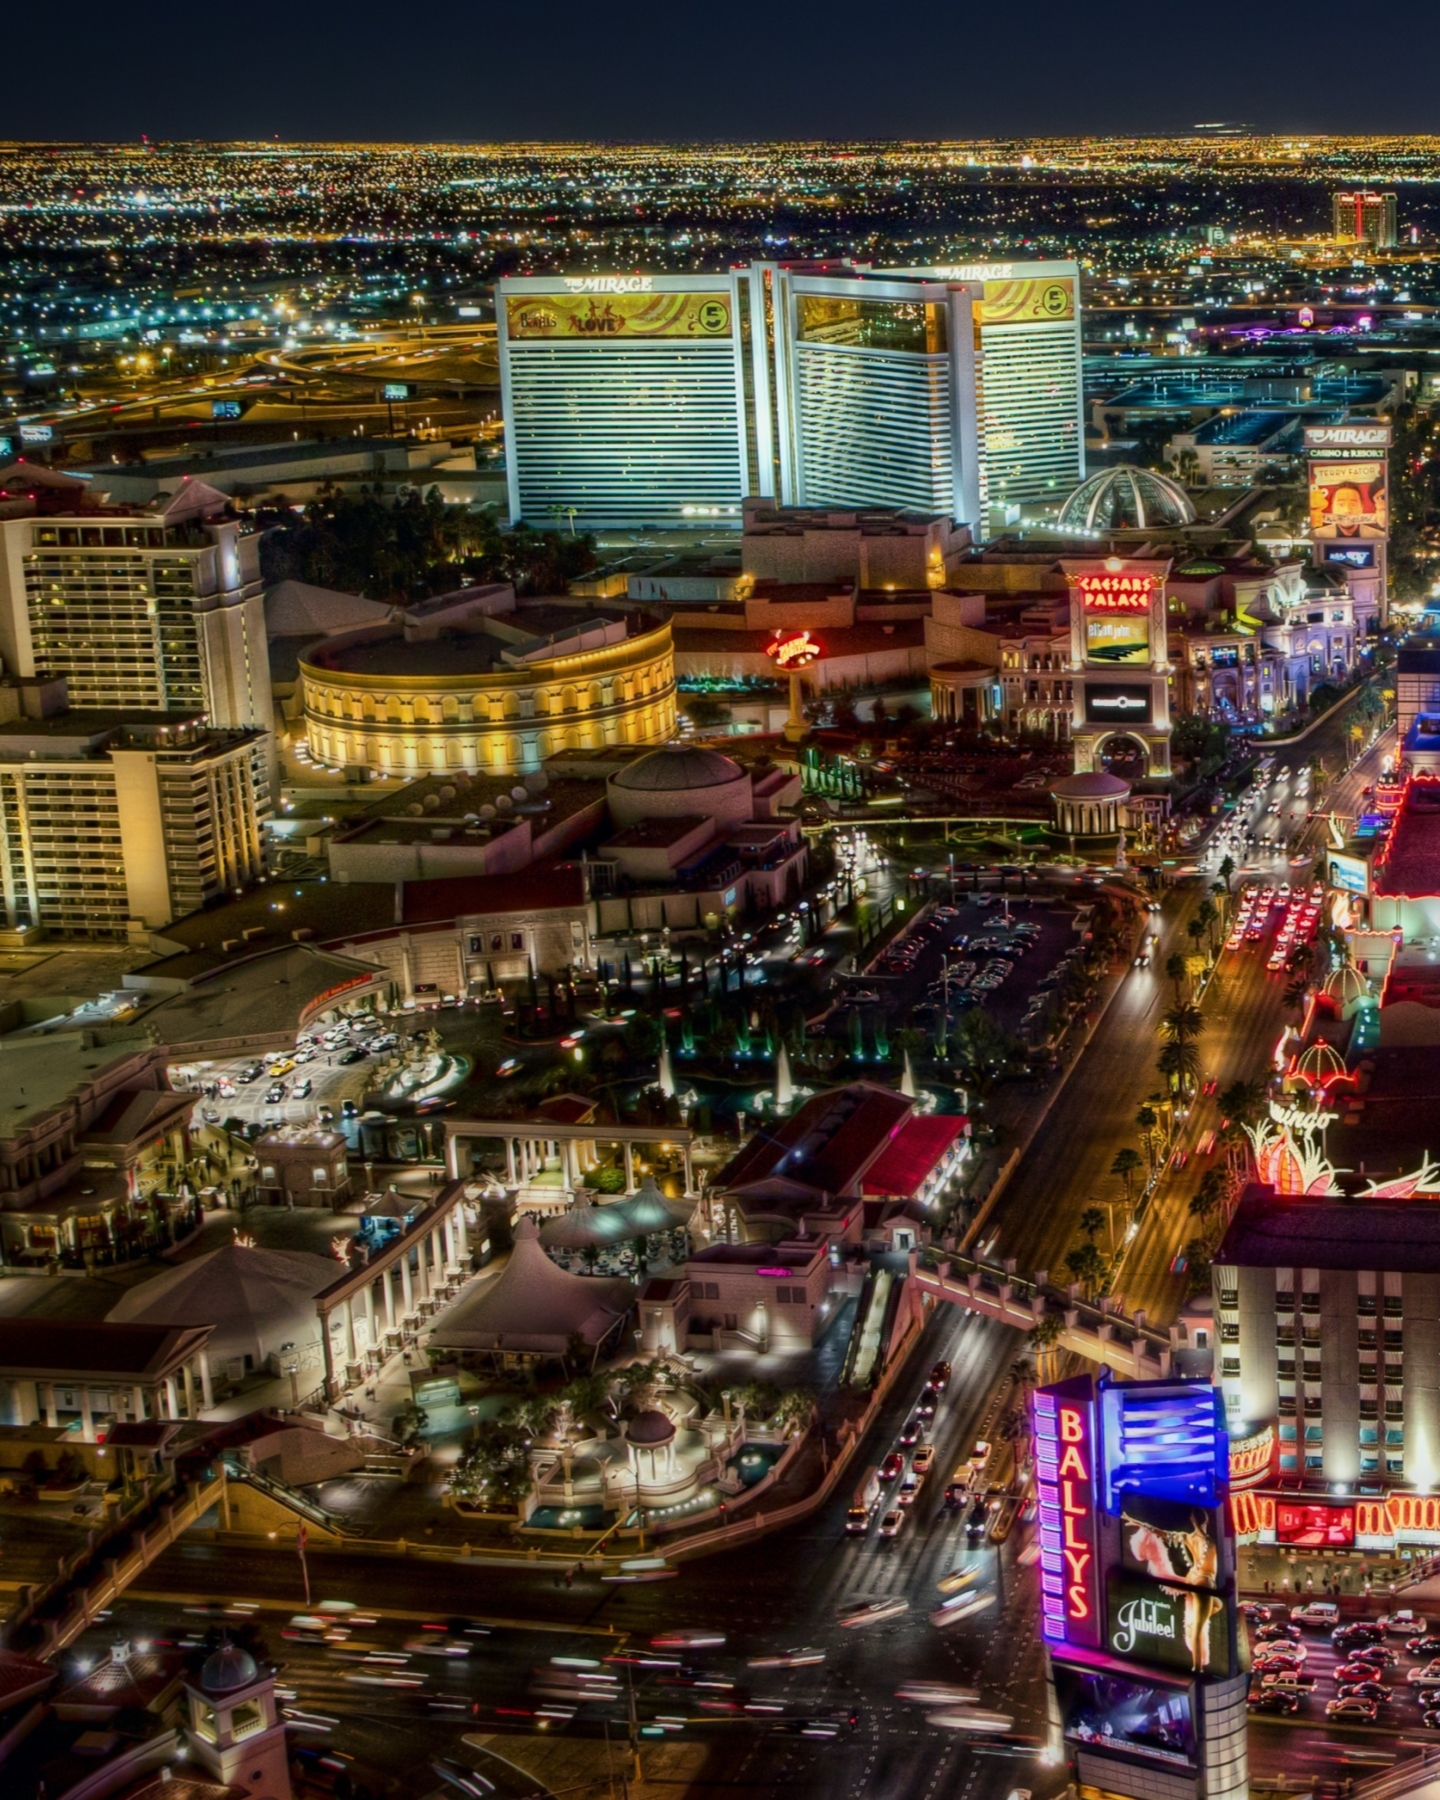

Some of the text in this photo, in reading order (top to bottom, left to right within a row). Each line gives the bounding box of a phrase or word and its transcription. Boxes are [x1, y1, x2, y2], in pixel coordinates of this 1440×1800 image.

[950, 265, 1013, 281] MIRAGE
[564, 277, 652, 293] THE MIRAGE
[577, 318, 616, 332] LOVE
[1307, 430, 1387, 444] THE MIRAGE
[1310, 449, 1384, 458] CASINO & RESORT
[1319, 467, 1375, 477] TERRY FATOR
[1080, 578, 1151, 591] CAESARS
[1085, 593, 1148, 607] PALACE
[1088, 623, 1130, 640] elton john
[1113, 1599, 1175, 1652] Jubilee!
